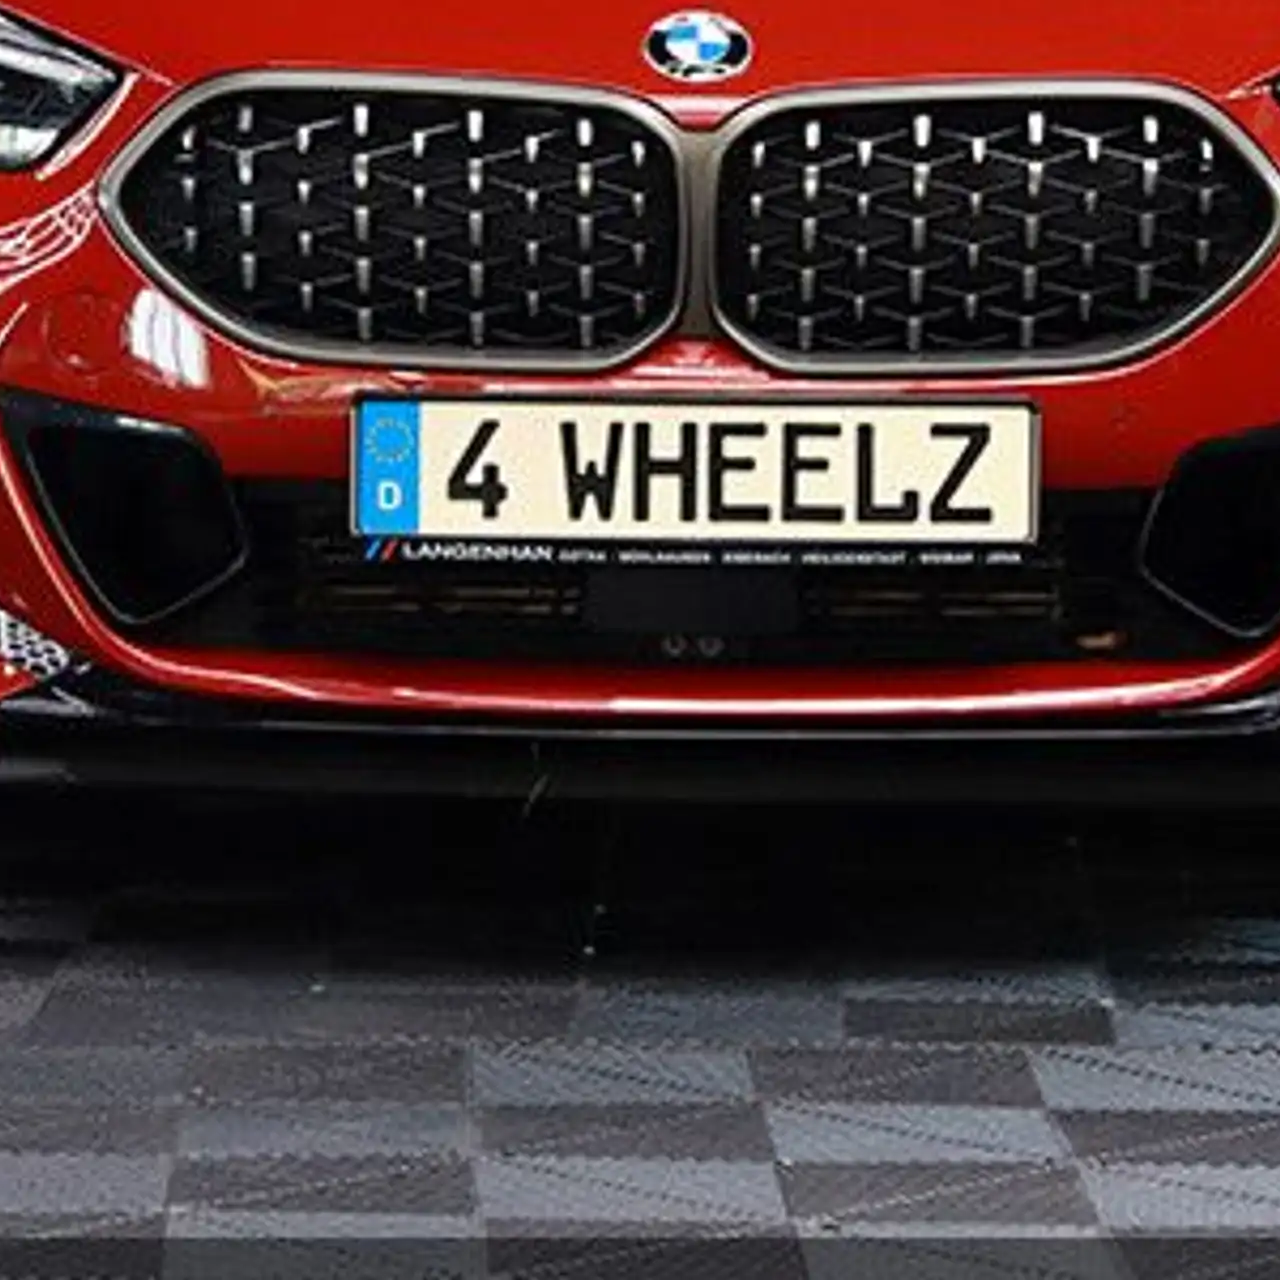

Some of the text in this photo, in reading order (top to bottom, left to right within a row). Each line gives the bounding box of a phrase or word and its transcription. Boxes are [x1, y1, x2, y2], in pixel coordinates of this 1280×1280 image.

[447, 420, 993, 523] 4 WHEELZ
[377, 481, 402, 509] D
[401, 540, 553, 562] LANGENHAN
